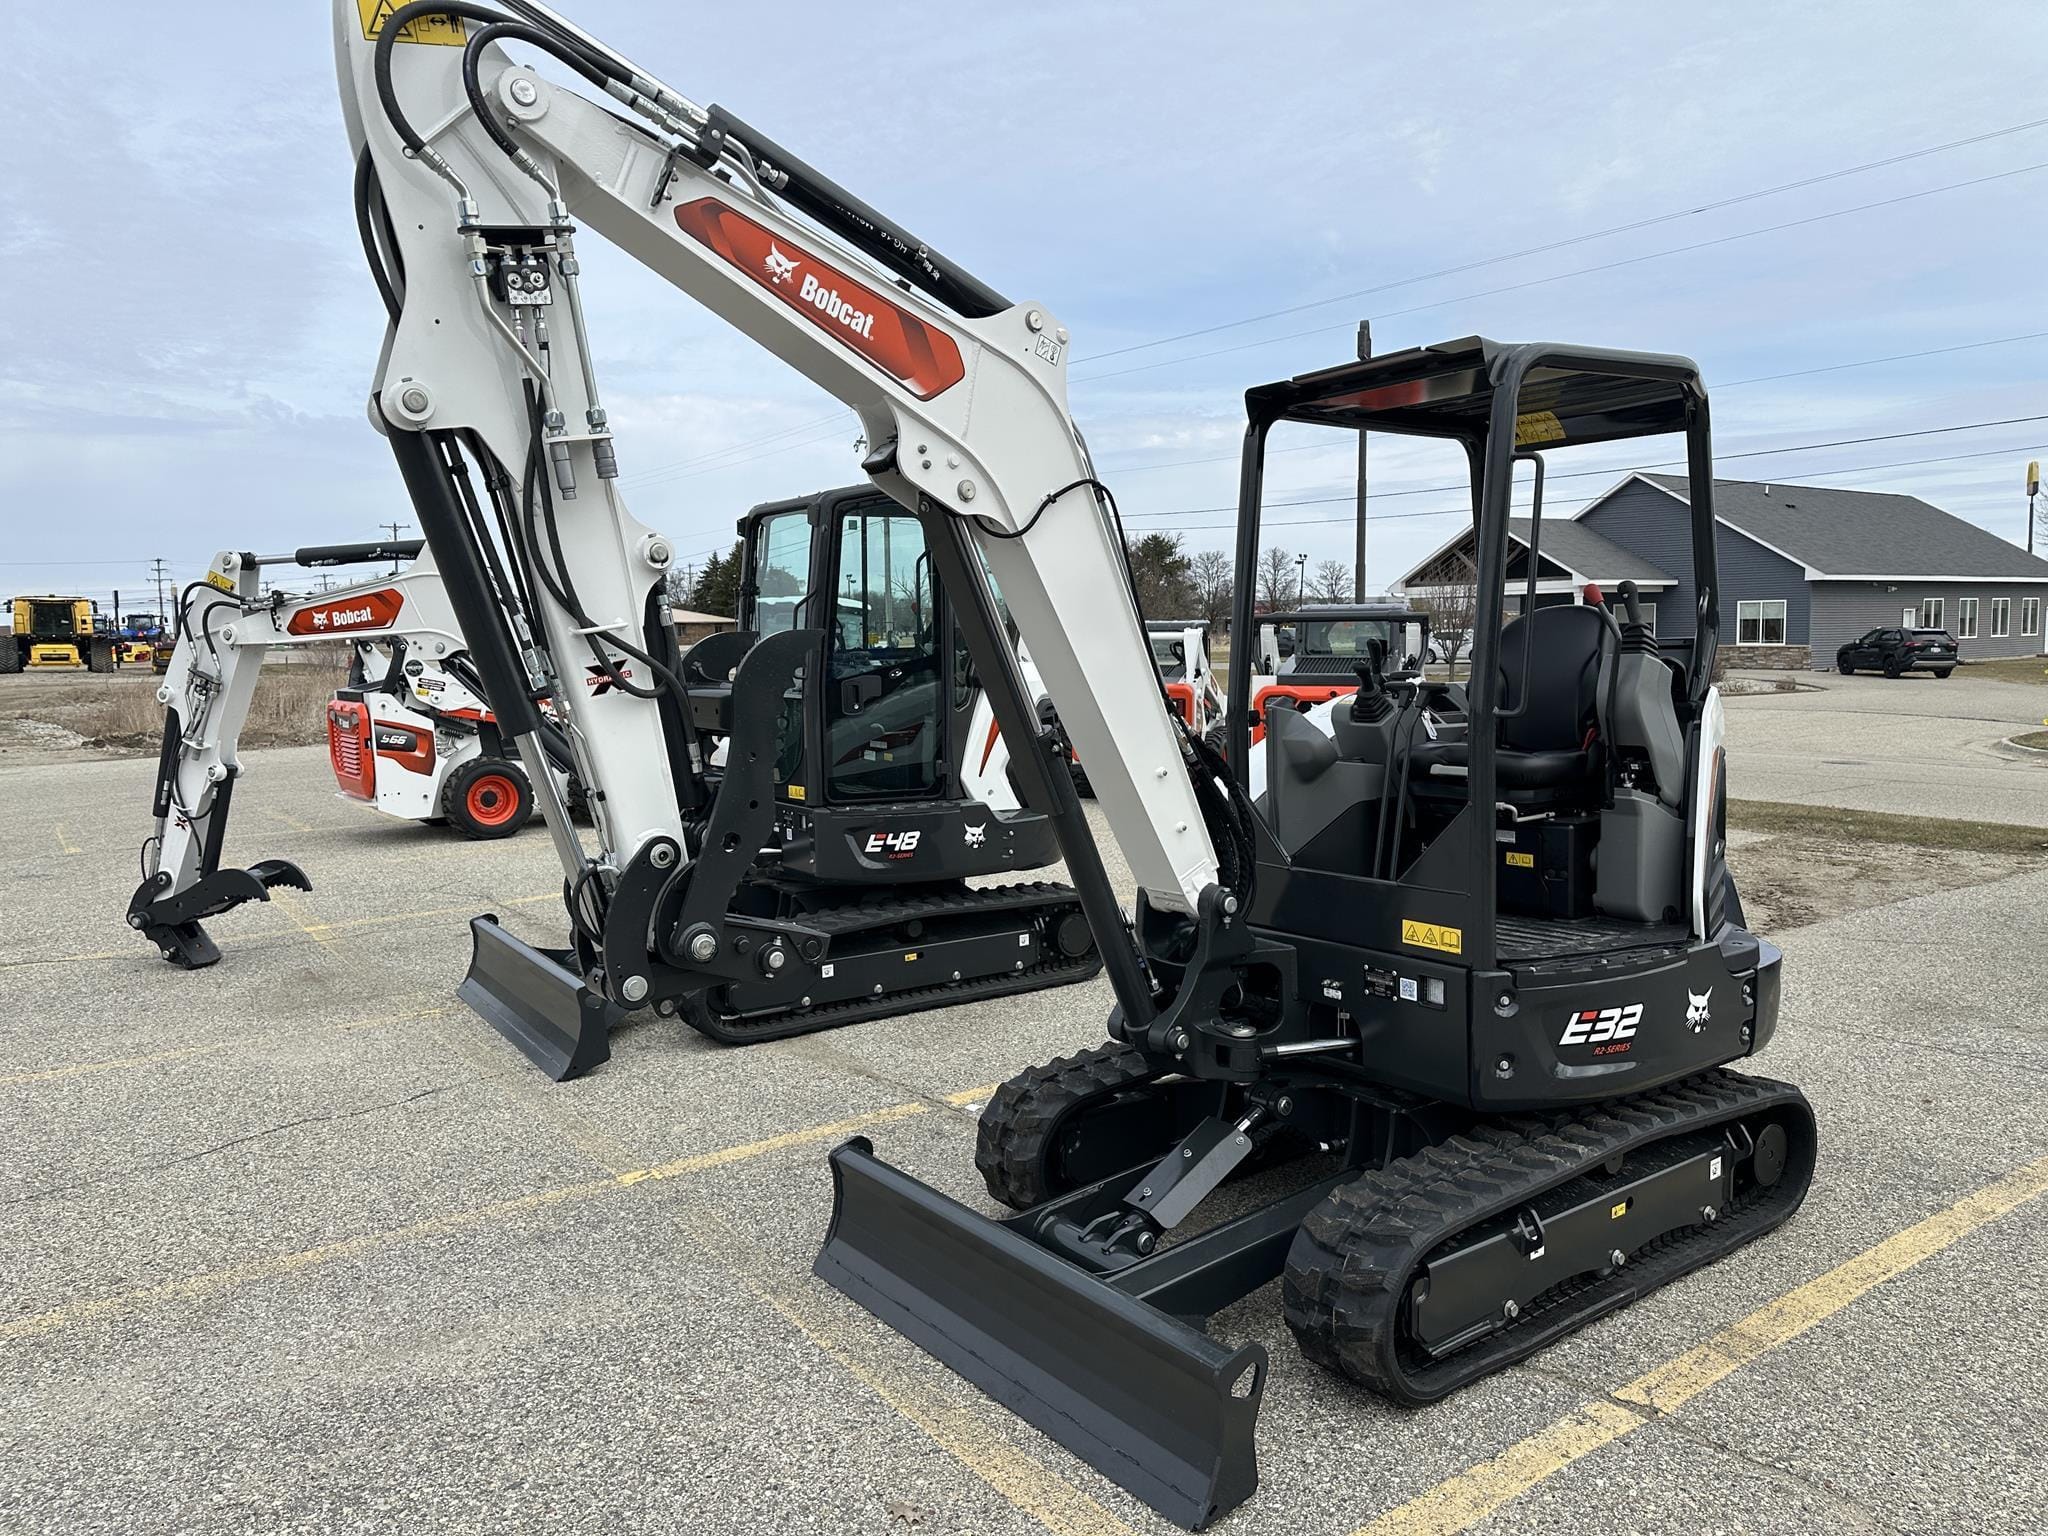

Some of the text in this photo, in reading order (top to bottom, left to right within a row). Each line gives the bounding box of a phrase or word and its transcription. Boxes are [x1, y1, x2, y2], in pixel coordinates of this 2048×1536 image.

[800, 272, 874, 339] Bobcat
[332, 606, 372, 626] Bobcat
[588, 671, 631, 684] HYDRIC
[380, 734, 408, 745] S66
[864, 830, 921, 853] E48
[1558, 1003, 1644, 1046] E32
[1593, 1042, 1632, 1056] R2-SERIES
